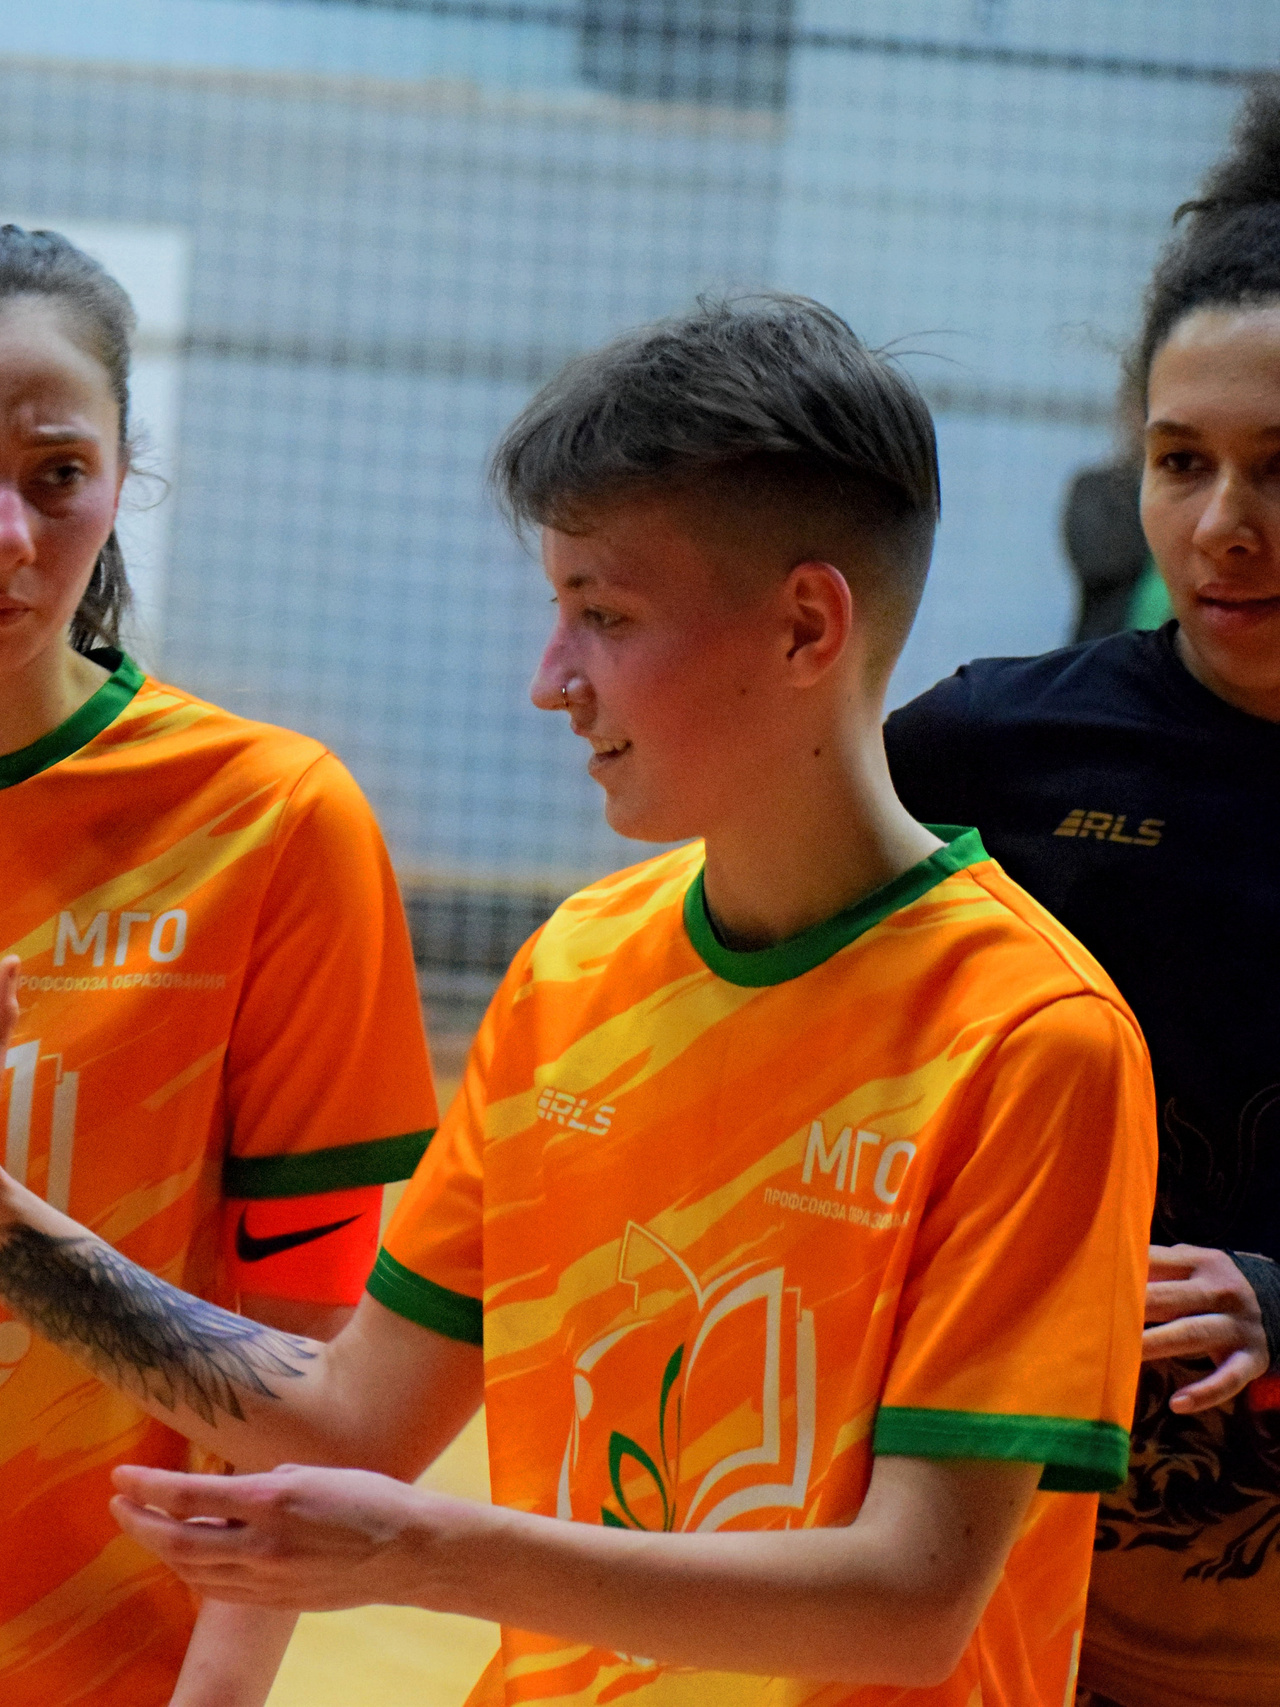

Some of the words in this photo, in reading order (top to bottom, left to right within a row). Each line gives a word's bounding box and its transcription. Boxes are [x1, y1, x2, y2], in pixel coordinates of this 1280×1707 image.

[53, 908, 188, 967] МГО
[18, 975, 108, 991] РОФСОЮЗА
[801, 1119, 918, 1205] МГО
[763, 1187, 847, 1220] ПРОФСОЮЗА
